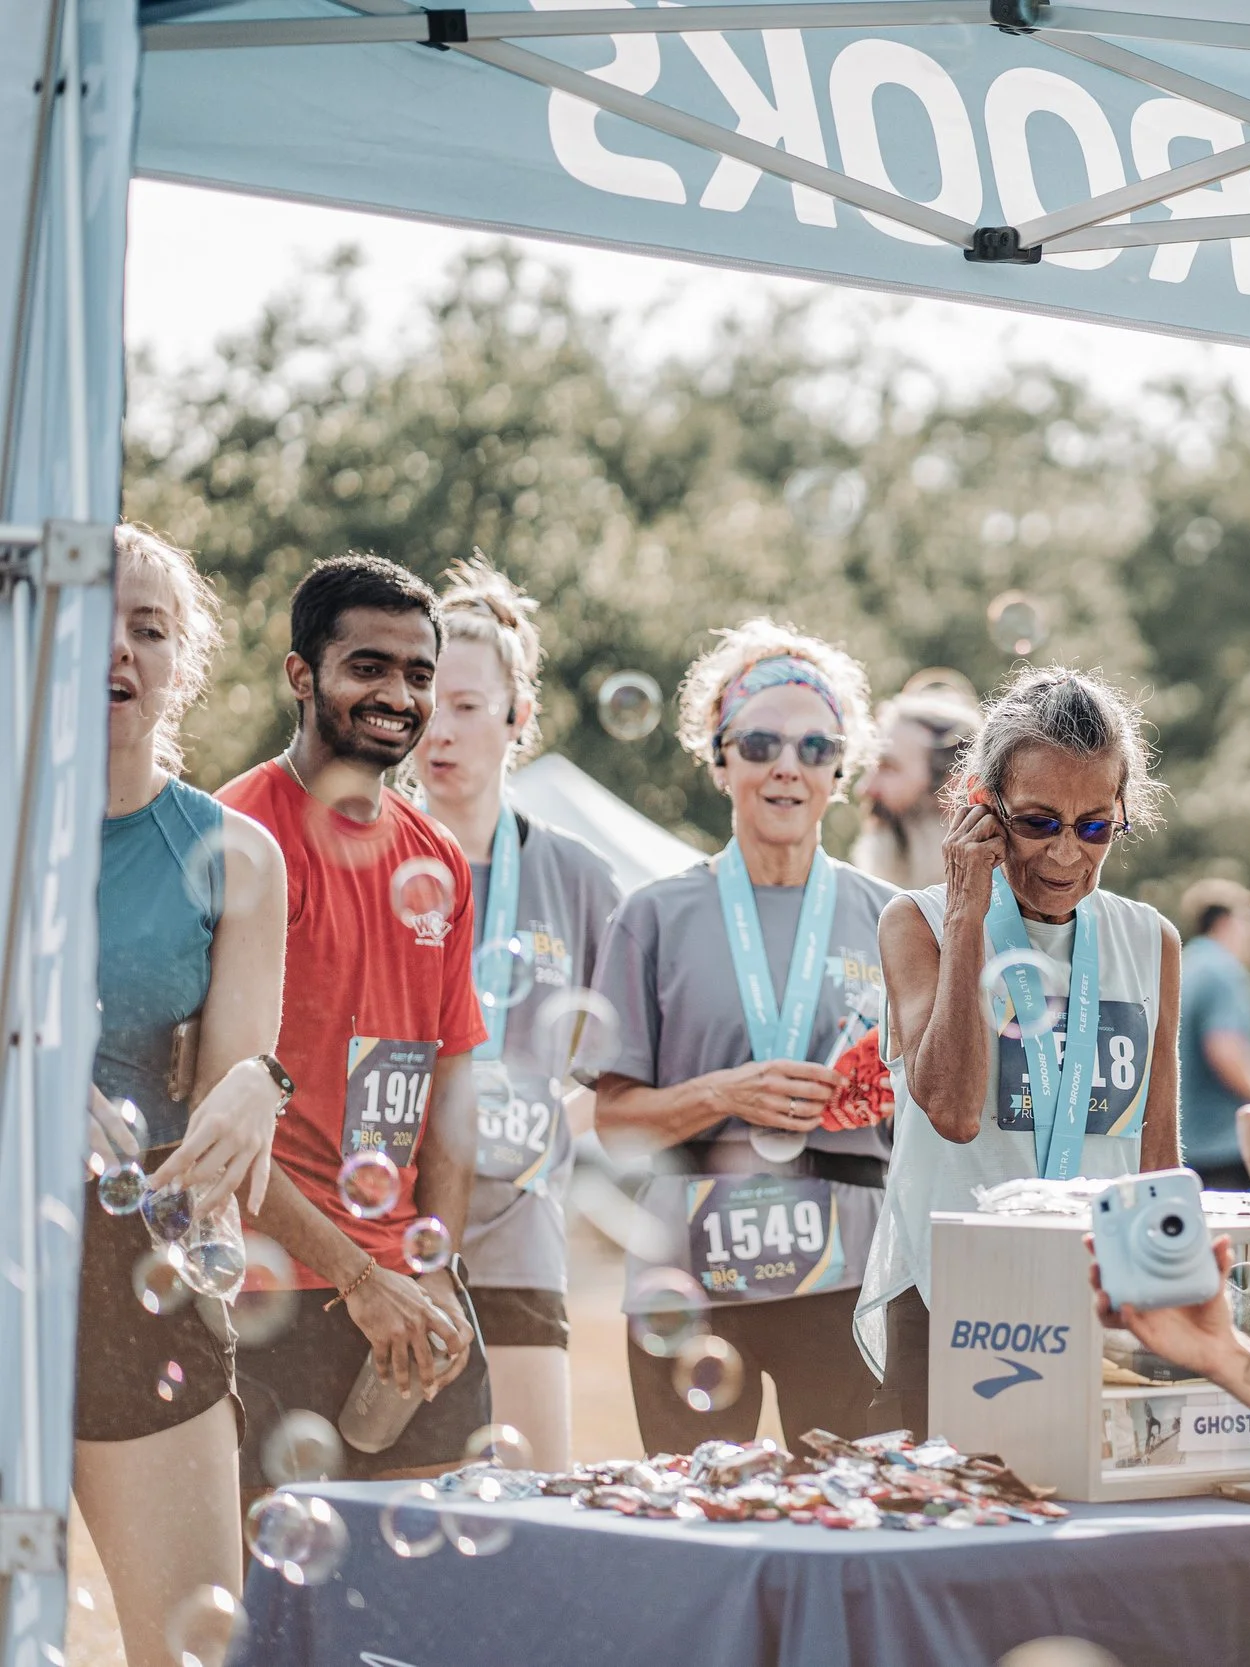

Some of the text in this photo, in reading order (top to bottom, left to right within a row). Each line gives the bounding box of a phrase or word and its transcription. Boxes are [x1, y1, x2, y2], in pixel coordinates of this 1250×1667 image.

[1080, 974, 1089, 1033] FLEET FEET
[1037, 1053, 1051, 1096] BROOKS
[1070, 1062, 1082, 1106] BROOKS
[361, 1131, 383, 1145] BIG
[703, 1200, 824, 1263] 1549
[711, 1269, 738, 1285] BIG
[754, 1261, 797, 1280] 2024
[951, 1320, 1070, 1354] BROOKS
